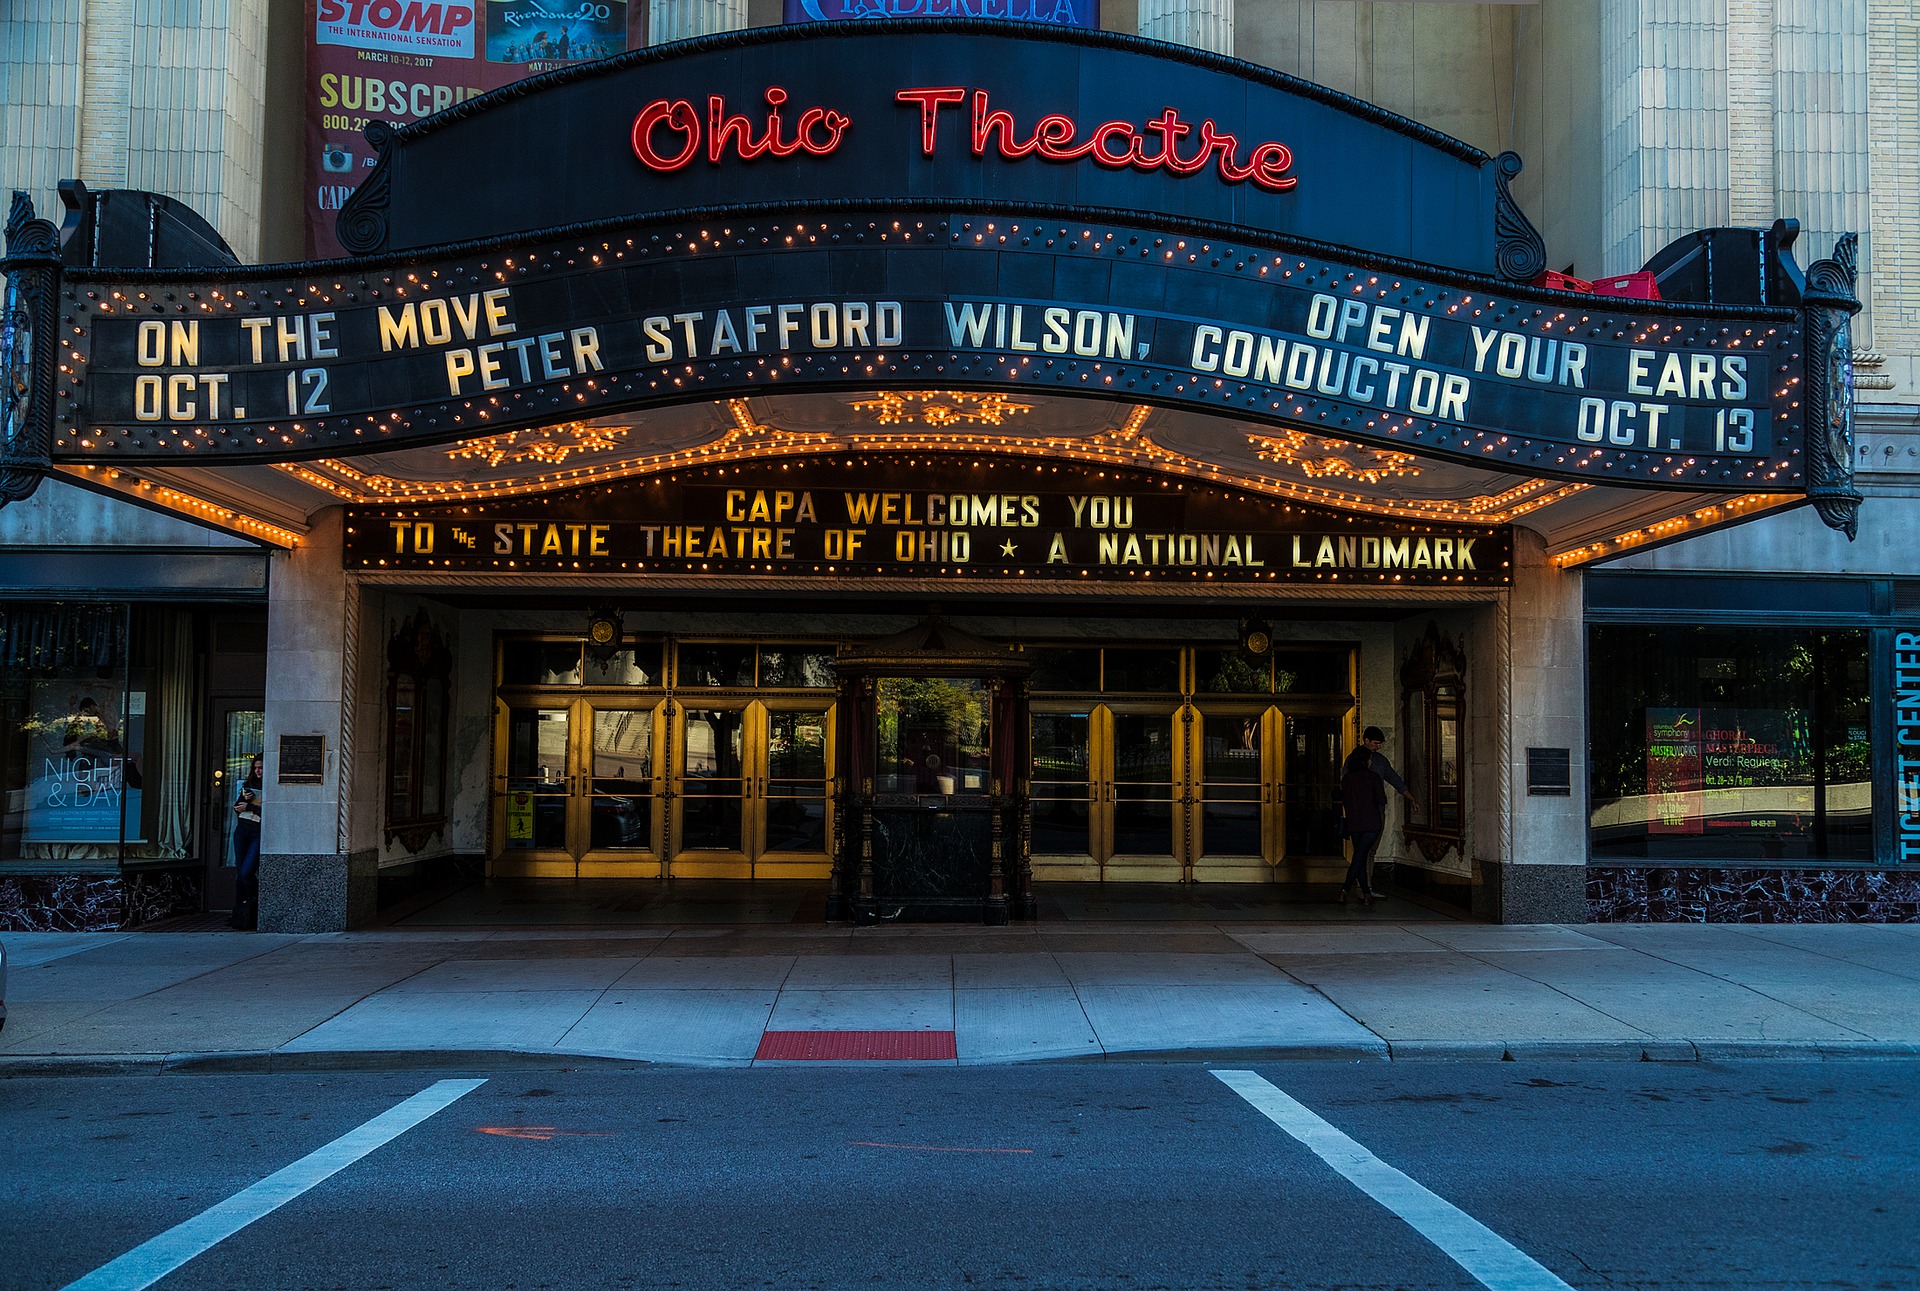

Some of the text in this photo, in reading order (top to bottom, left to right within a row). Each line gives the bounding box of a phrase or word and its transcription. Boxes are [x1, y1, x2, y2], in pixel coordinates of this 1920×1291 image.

[318, 0, 474, 35] STOMP
[504, 1, 611, 27] Riverdance 20
[328, 26, 462, 47] THE INTERNATIONAL SENSATION
[357, 51, 433, 67] MARCH 10-12, 2017
[528, 62, 543, 72] MAY
[631, 85, 1299, 192] Ohio Theatre
[318, 185, 357, 210] CAP
[137, 287, 517, 368] ON THE MOVE
[445, 301, 1471, 422] PETER STAFFORD WILSON, CONDUCTOR
[1306, 293, 1748, 401] OPEN YOUR EARS
[135, 367, 331, 422] OCT. 12
[1578, 397, 1755, 453] OCT. 13
[726, 489, 1134, 529] CAPA WELCOMES YOU
[389, 522, 1477, 571] TO THE STATE THEATRE OF OHIO A NATIONAL LANDMARK
[1653, 729, 1690, 739] symphony
[1705, 730, 1749, 740] CHORAL
[1896, 632, 1920, 860] TICKET CENTER
[44, 758, 132, 782] NIGHT
[1705, 755, 1780, 768] Verdi: Requiem
[47, 782, 123, 808] & DAY
